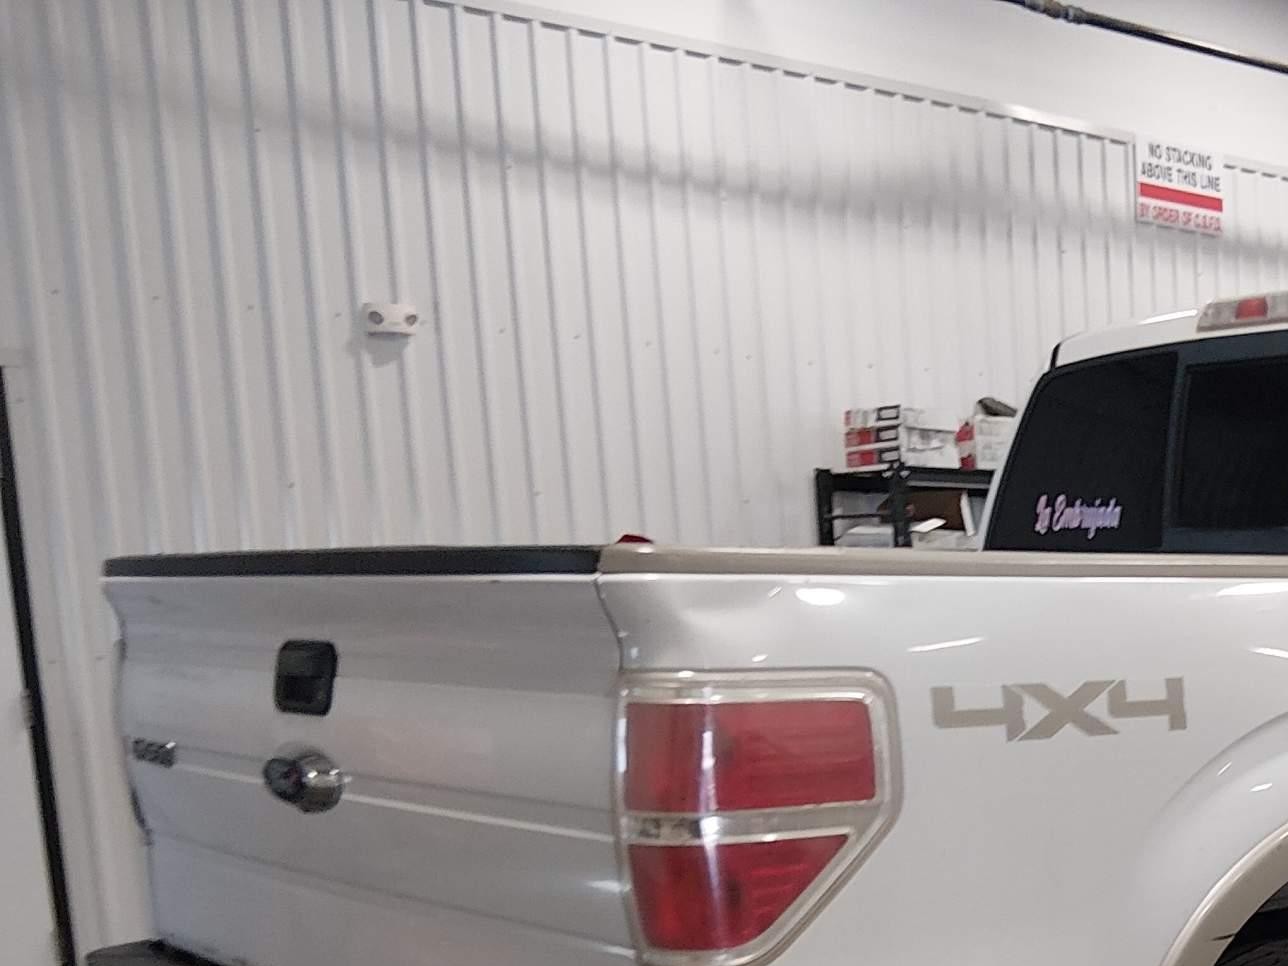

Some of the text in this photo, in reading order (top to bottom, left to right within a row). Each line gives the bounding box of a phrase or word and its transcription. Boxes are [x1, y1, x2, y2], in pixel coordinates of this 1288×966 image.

[1147, 143, 1212, 171] NO STACKING
[1141, 162, 1221, 193] ABOVE THIS LINE
[1152, 205, 1180, 224] ORDER
[1182, 210, 1194, 226] OF
